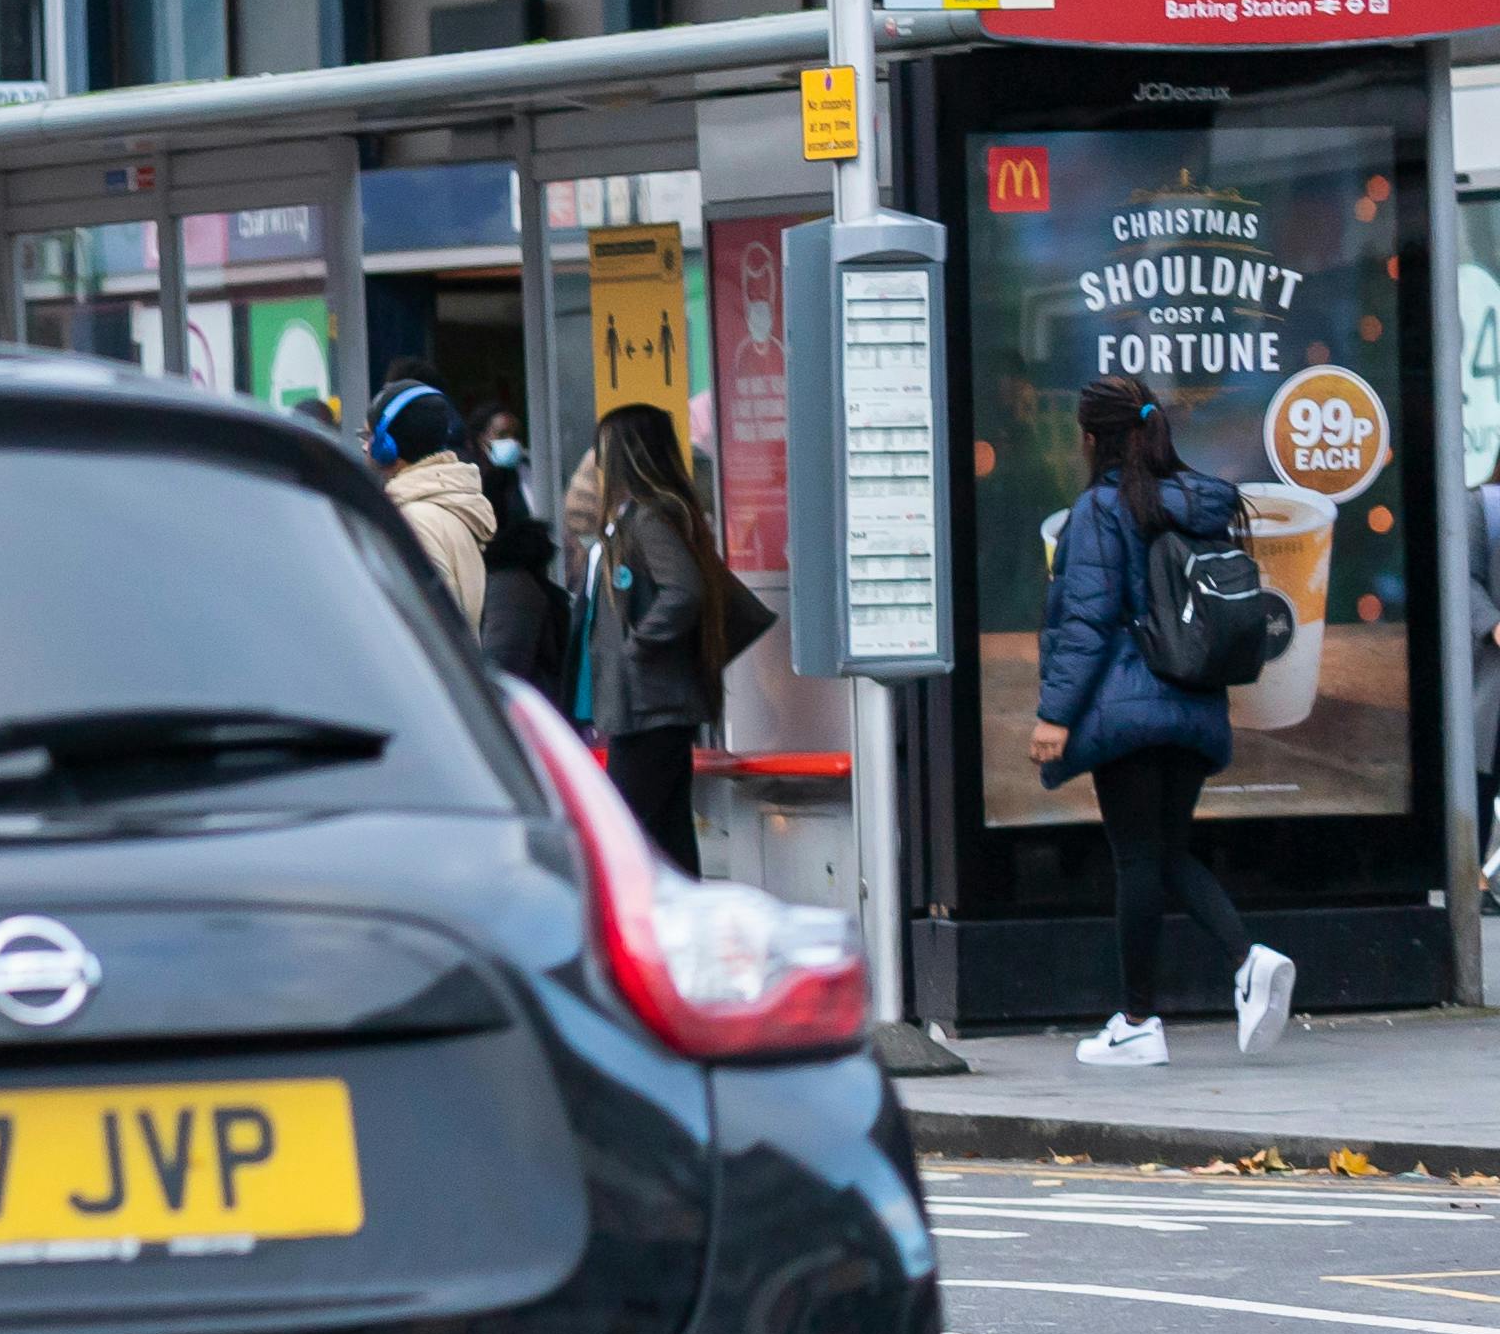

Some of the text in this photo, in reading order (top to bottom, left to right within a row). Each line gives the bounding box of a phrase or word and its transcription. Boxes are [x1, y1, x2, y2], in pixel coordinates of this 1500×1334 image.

[1133, 82, 1231, 101] JCDecaux
[1112, 208, 1259, 242] CHRISTMAS
[1079, 255, 1303, 312] SHOULDN'T
[1149, 306, 1225, 324] COST A
[1097, 332, 1281, 375] FORTUNE
[1294, 447, 1361, 472] EACH
[67, 1103, 277, 1216] JVP
